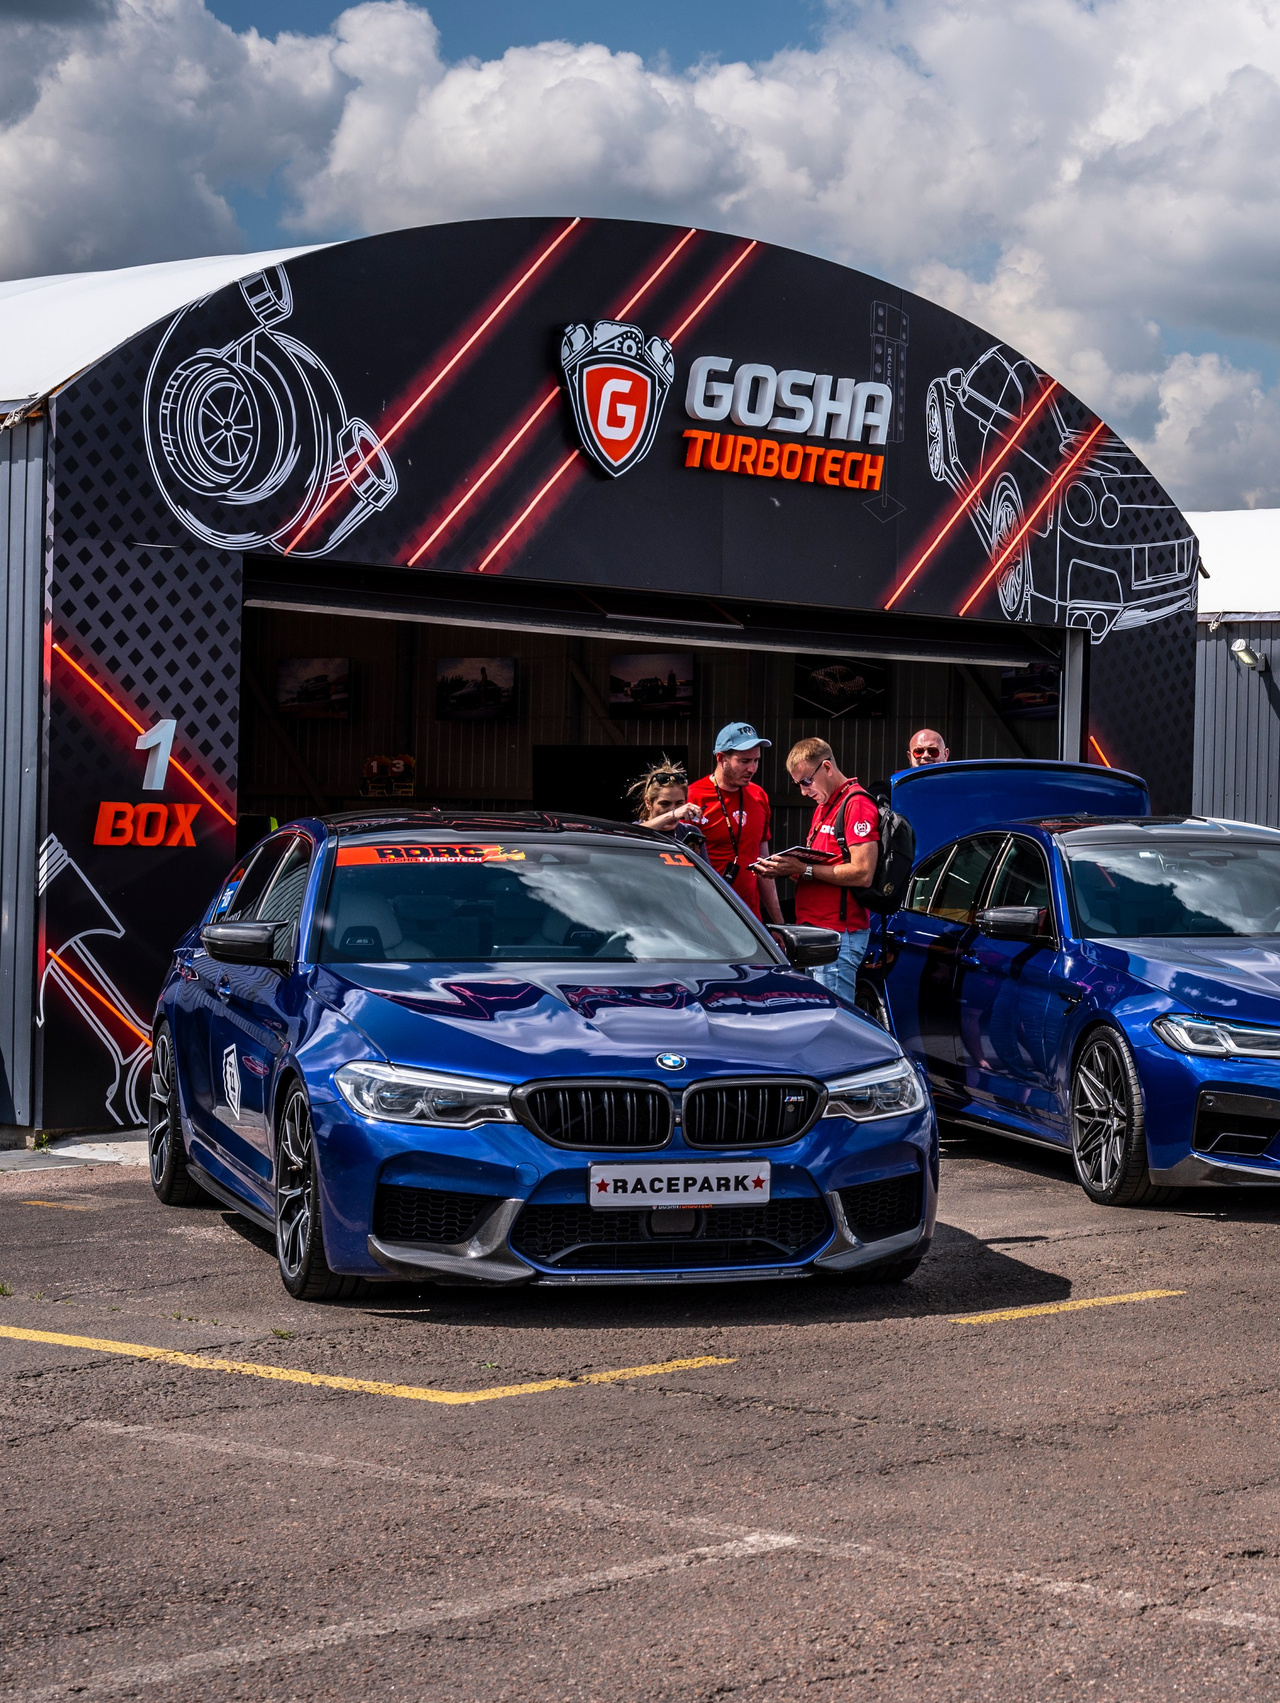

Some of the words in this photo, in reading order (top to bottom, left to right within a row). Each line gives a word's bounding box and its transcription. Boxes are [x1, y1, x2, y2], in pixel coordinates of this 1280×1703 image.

[685, 355, 893, 446] GOSHA
[682, 429, 885, 491] TURBOTECH
[135, 719, 177, 790] 1
[93, 801, 202, 847] BOX
[612, 1175, 750, 1193] RACEPARK
